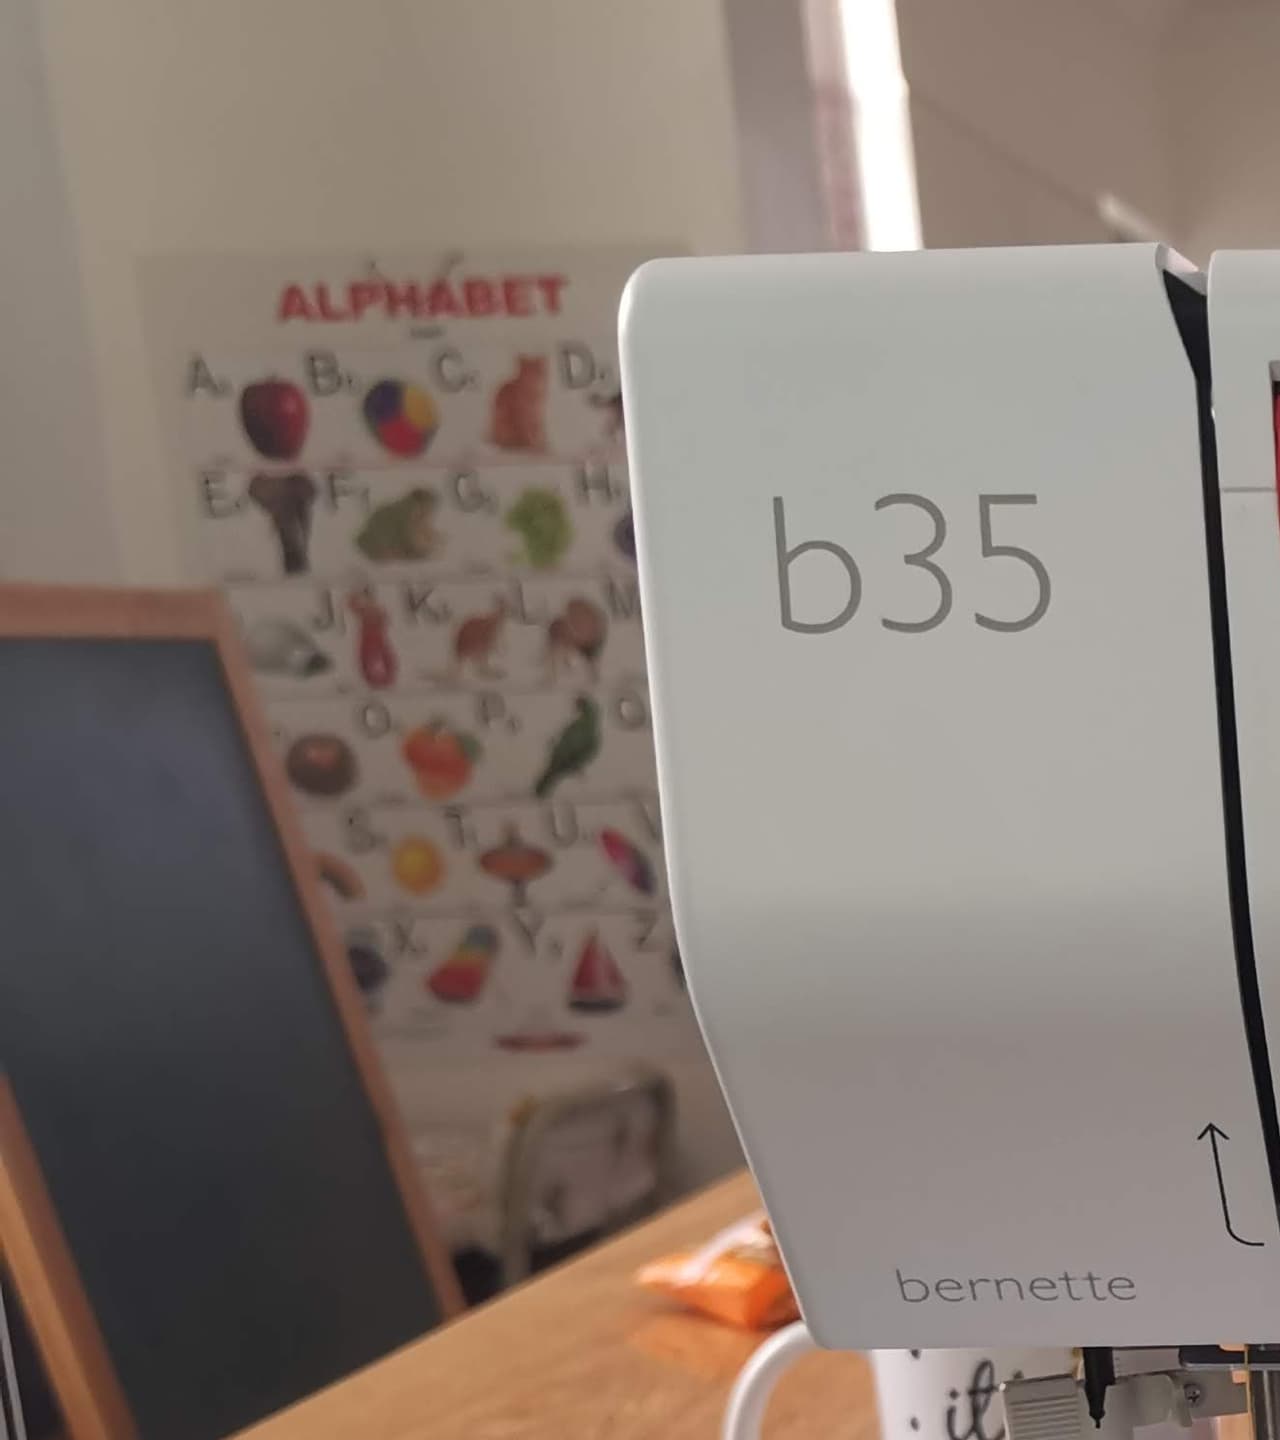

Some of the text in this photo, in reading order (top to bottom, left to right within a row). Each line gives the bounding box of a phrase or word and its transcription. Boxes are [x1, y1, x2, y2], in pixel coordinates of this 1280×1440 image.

[278, 274, 568, 323] ALPHABET
[773, 494, 1051, 634] b35
[896, 1269, 1137, 1303] bernette
